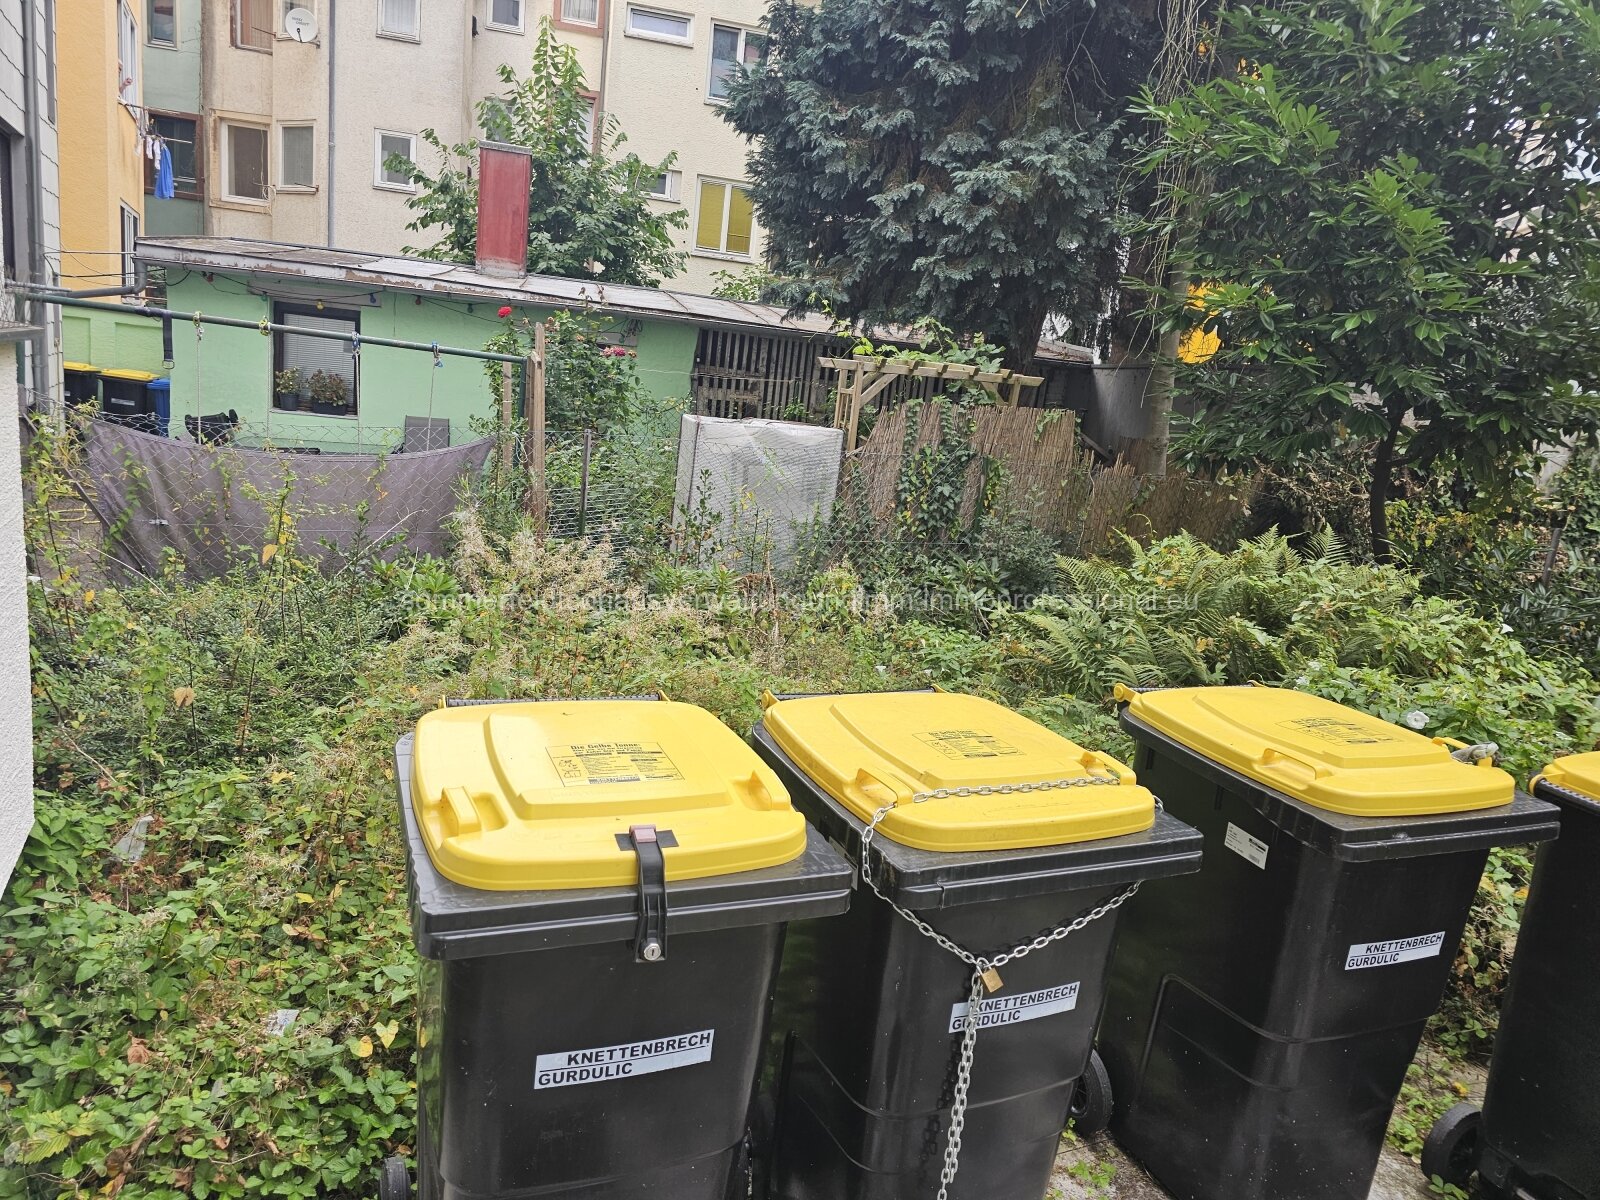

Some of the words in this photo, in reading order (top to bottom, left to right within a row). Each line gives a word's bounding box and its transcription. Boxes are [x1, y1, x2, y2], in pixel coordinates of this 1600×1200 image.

[1365, 933, 1443, 954] KNETTENBRECH
[1347, 953, 1400, 968] GURDULIC
[567, 1032, 711, 1066] KNETTENBRECH
[538, 1062, 633, 1086] GURDULIC
